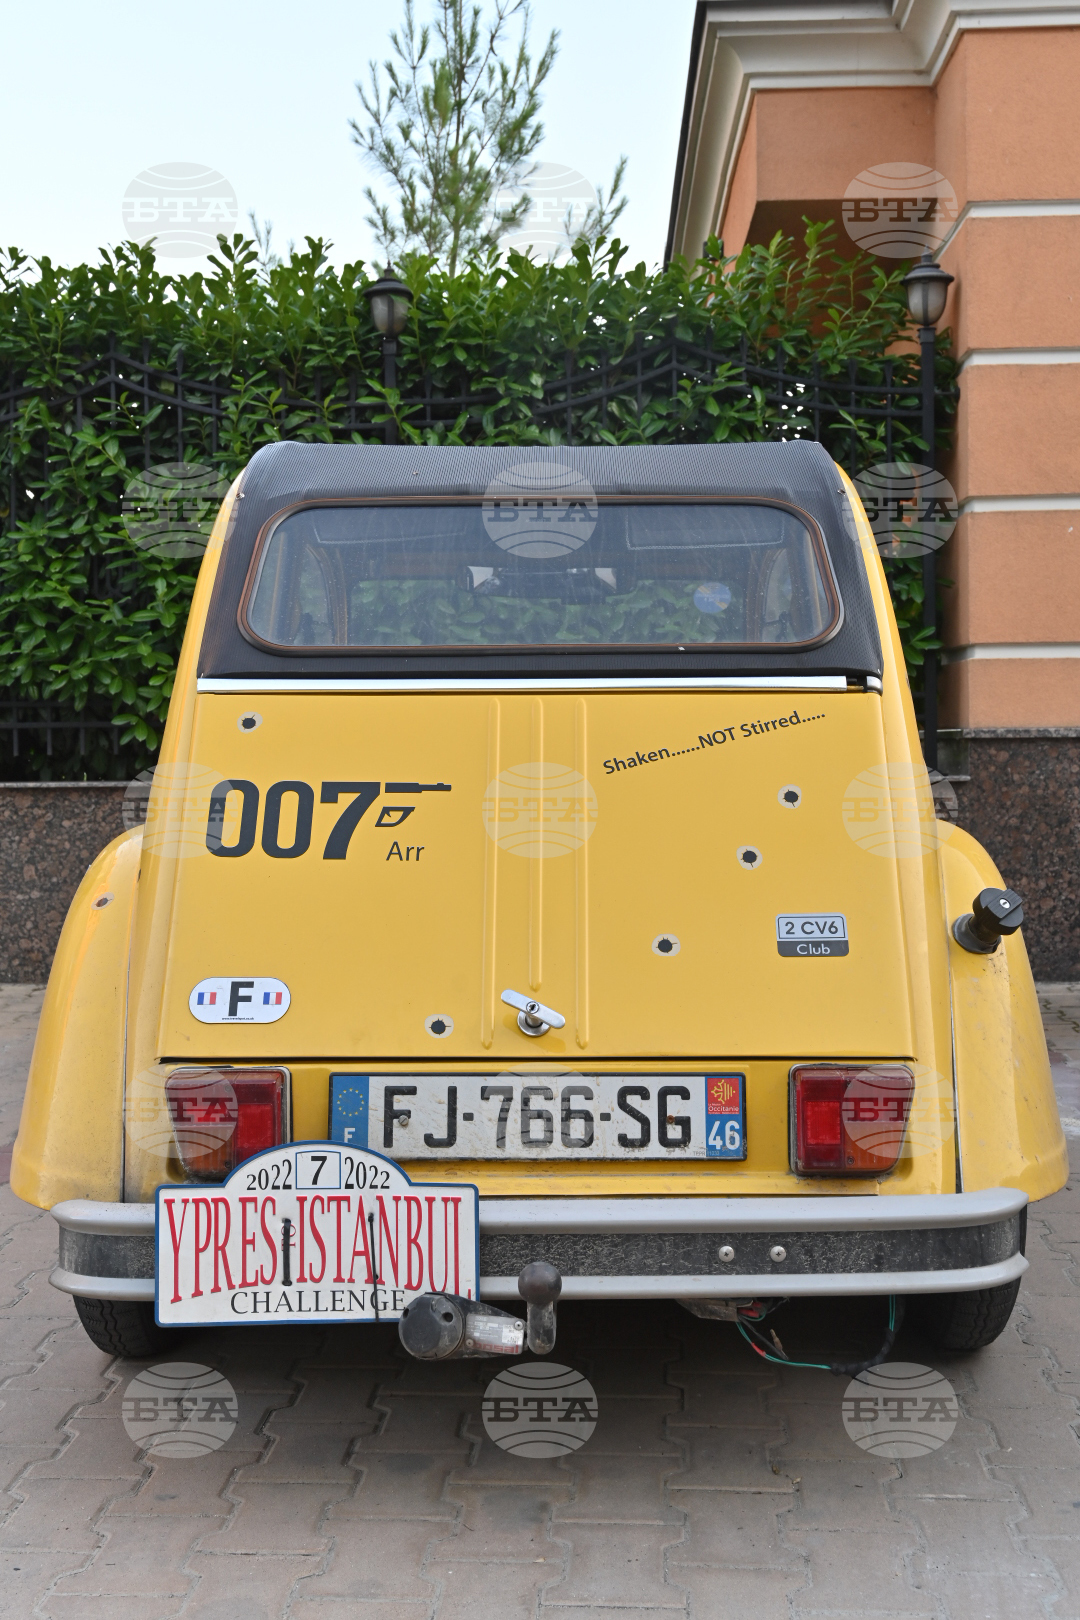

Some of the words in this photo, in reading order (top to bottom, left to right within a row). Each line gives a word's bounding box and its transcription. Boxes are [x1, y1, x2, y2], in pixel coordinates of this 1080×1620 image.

[205, 779, 381, 860] 007
[386, 841, 425, 861] Arr
[785, 921, 796, 935] 2
[801, 920, 839, 935] CV6
[796, 943, 831, 955] Club
[228, 981, 254, 1017] F
[384, 1085, 692, 1149] FJ-766-SG
[344, 1127, 356, 1143] F
[708, 1120, 741, 1150] 46
[246, 1159, 292, 1190] 2022
[310, 1155, 328, 1186] 7
[344, 1156, 391, 1190] 2022
[163, 1195, 278, 1304] YPRES
[296, 1194, 472, 1300] ISTANBUL
[230, 1289, 407, 1315] CHALLENGE
